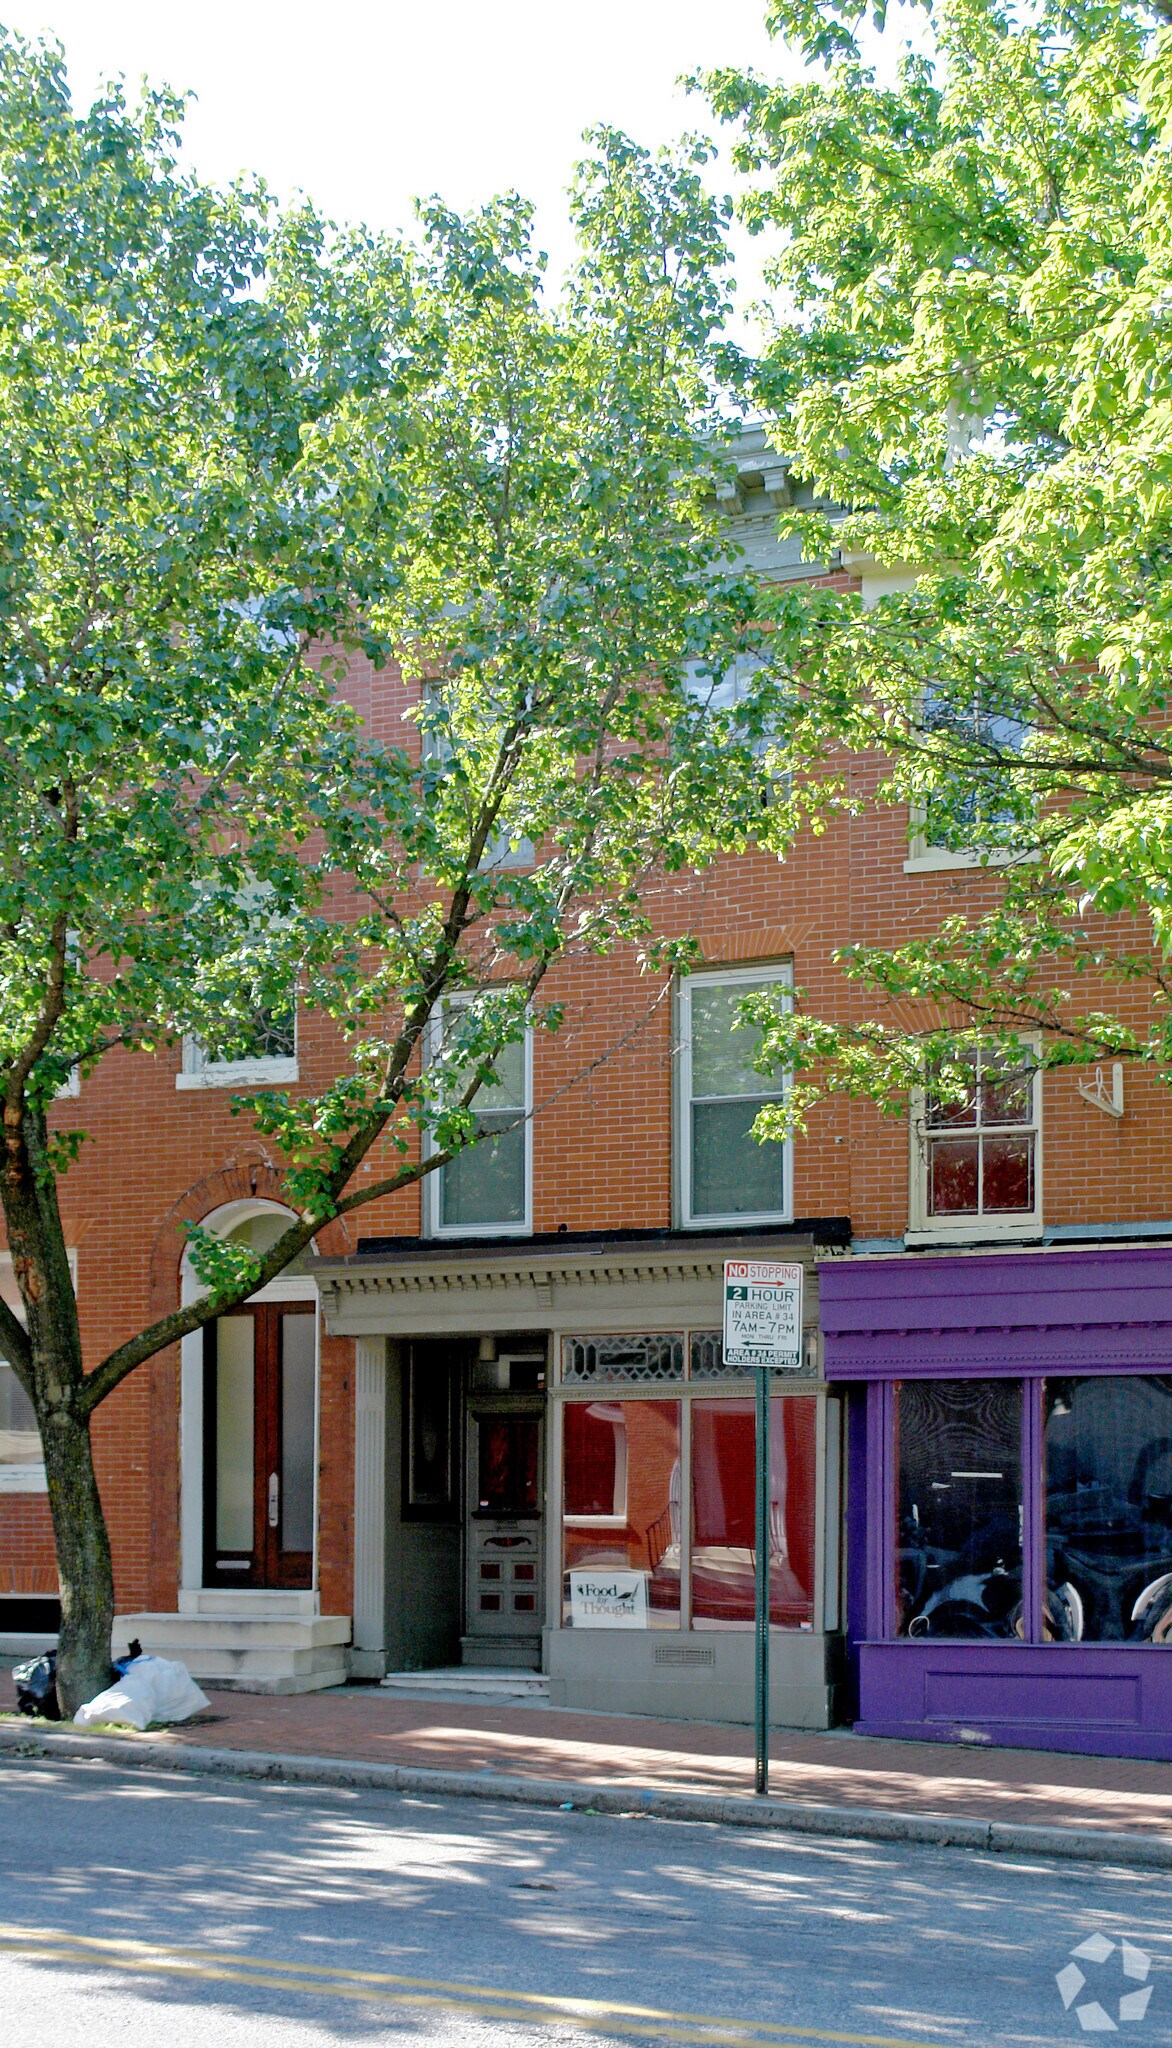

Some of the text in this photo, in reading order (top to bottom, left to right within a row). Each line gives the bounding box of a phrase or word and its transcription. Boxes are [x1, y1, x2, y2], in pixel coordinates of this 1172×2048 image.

[728, 1264, 798, 1279] NO STOPPING
[733, 1287, 794, 1302] 2 HOUR
[734, 1302, 768, 1310] PARKING
[732, 1310, 742, 1318] IN
[745, 1312, 772, 1320] AREA
[732, 1320, 757, 1332] 7AM
[768, 1322, 794, 1334] 7PM
[768, 1350, 798, 1358] PERMIT
[761, 1357, 798, 1365] EXCEPTED
[586, 1584, 618, 1596] Food
[581, 1602, 636, 1618] Thought
